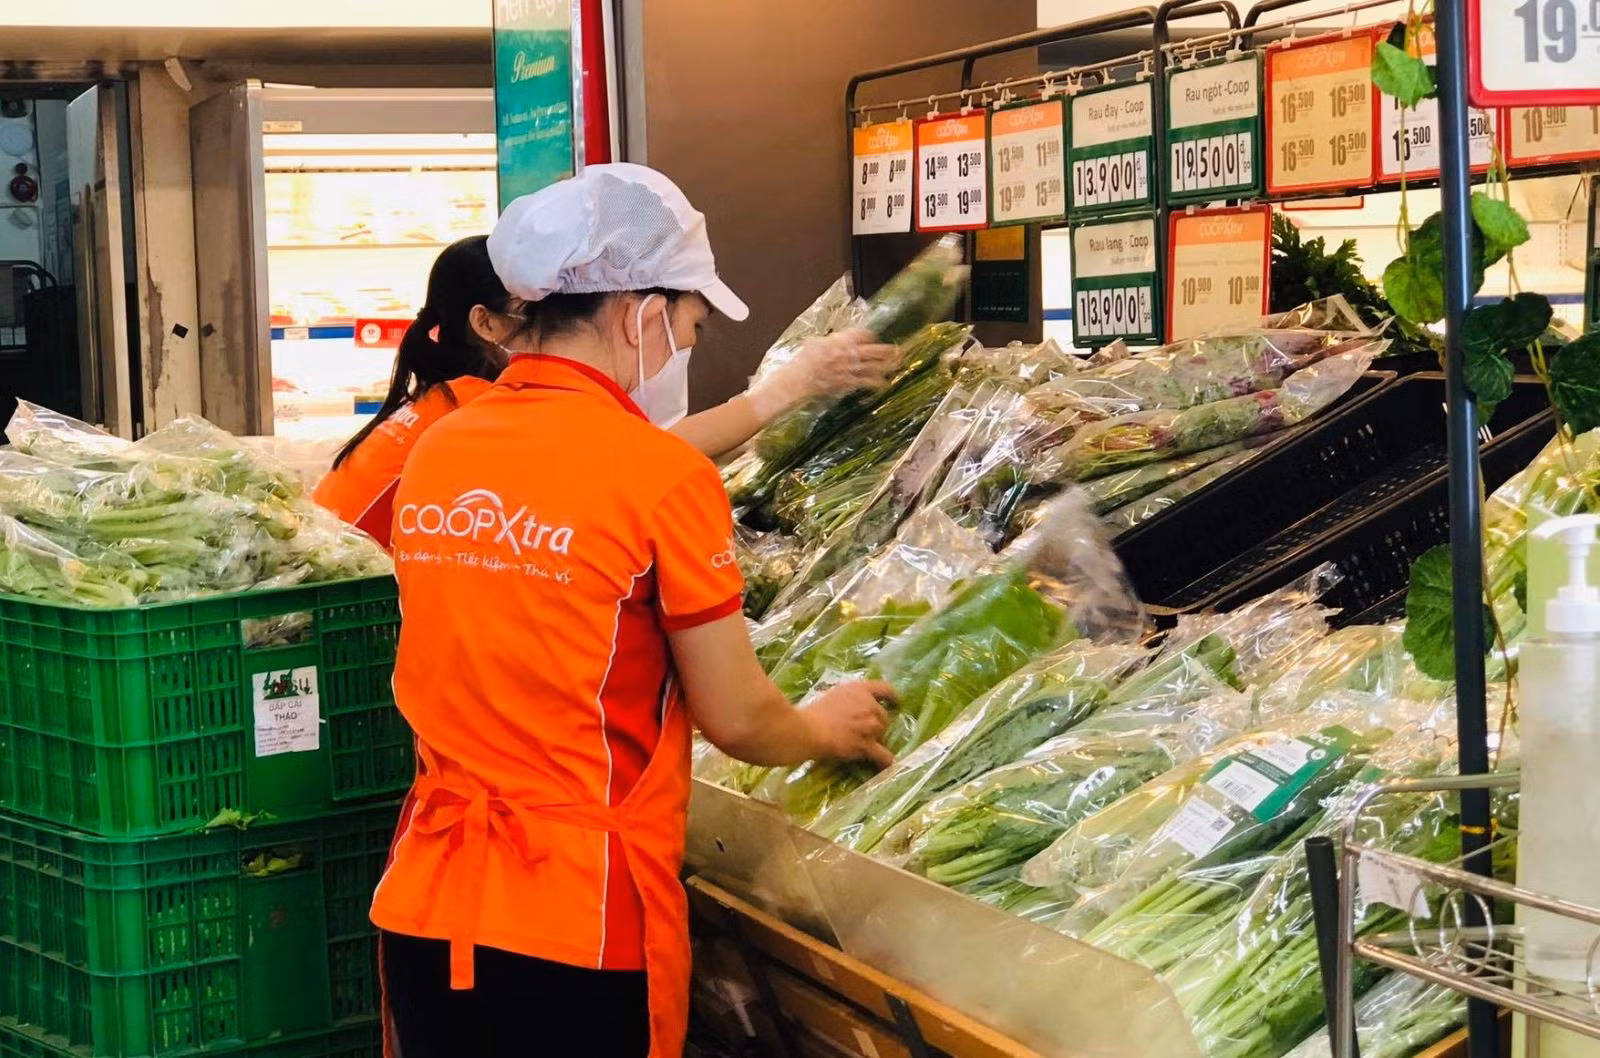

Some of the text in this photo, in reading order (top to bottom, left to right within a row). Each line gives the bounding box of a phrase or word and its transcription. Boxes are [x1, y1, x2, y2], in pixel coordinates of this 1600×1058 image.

[511, 51, 557, 83] Premium
[1088, 106, 1103, 121] Rau
[1125, 99, 1145, 114] Coop
[1185, 88, 1200, 102] Rau
[1280, 90, 1314, 124] 16.500
[1329, 83, 1366, 118] 16.500
[1175, 142, 1235, 180] 19.500
[1280, 138, 1315, 172] 16.500
[1329, 131, 1367, 166] 16.500
[1076, 160, 1133, 196] 13.900
[1090, 239, 1105, 252] Rau
[1106, 237, 1123, 253] lang
[1129, 234, 1149, 249] Coop
[1080, 294, 1137, 326] 13.900
